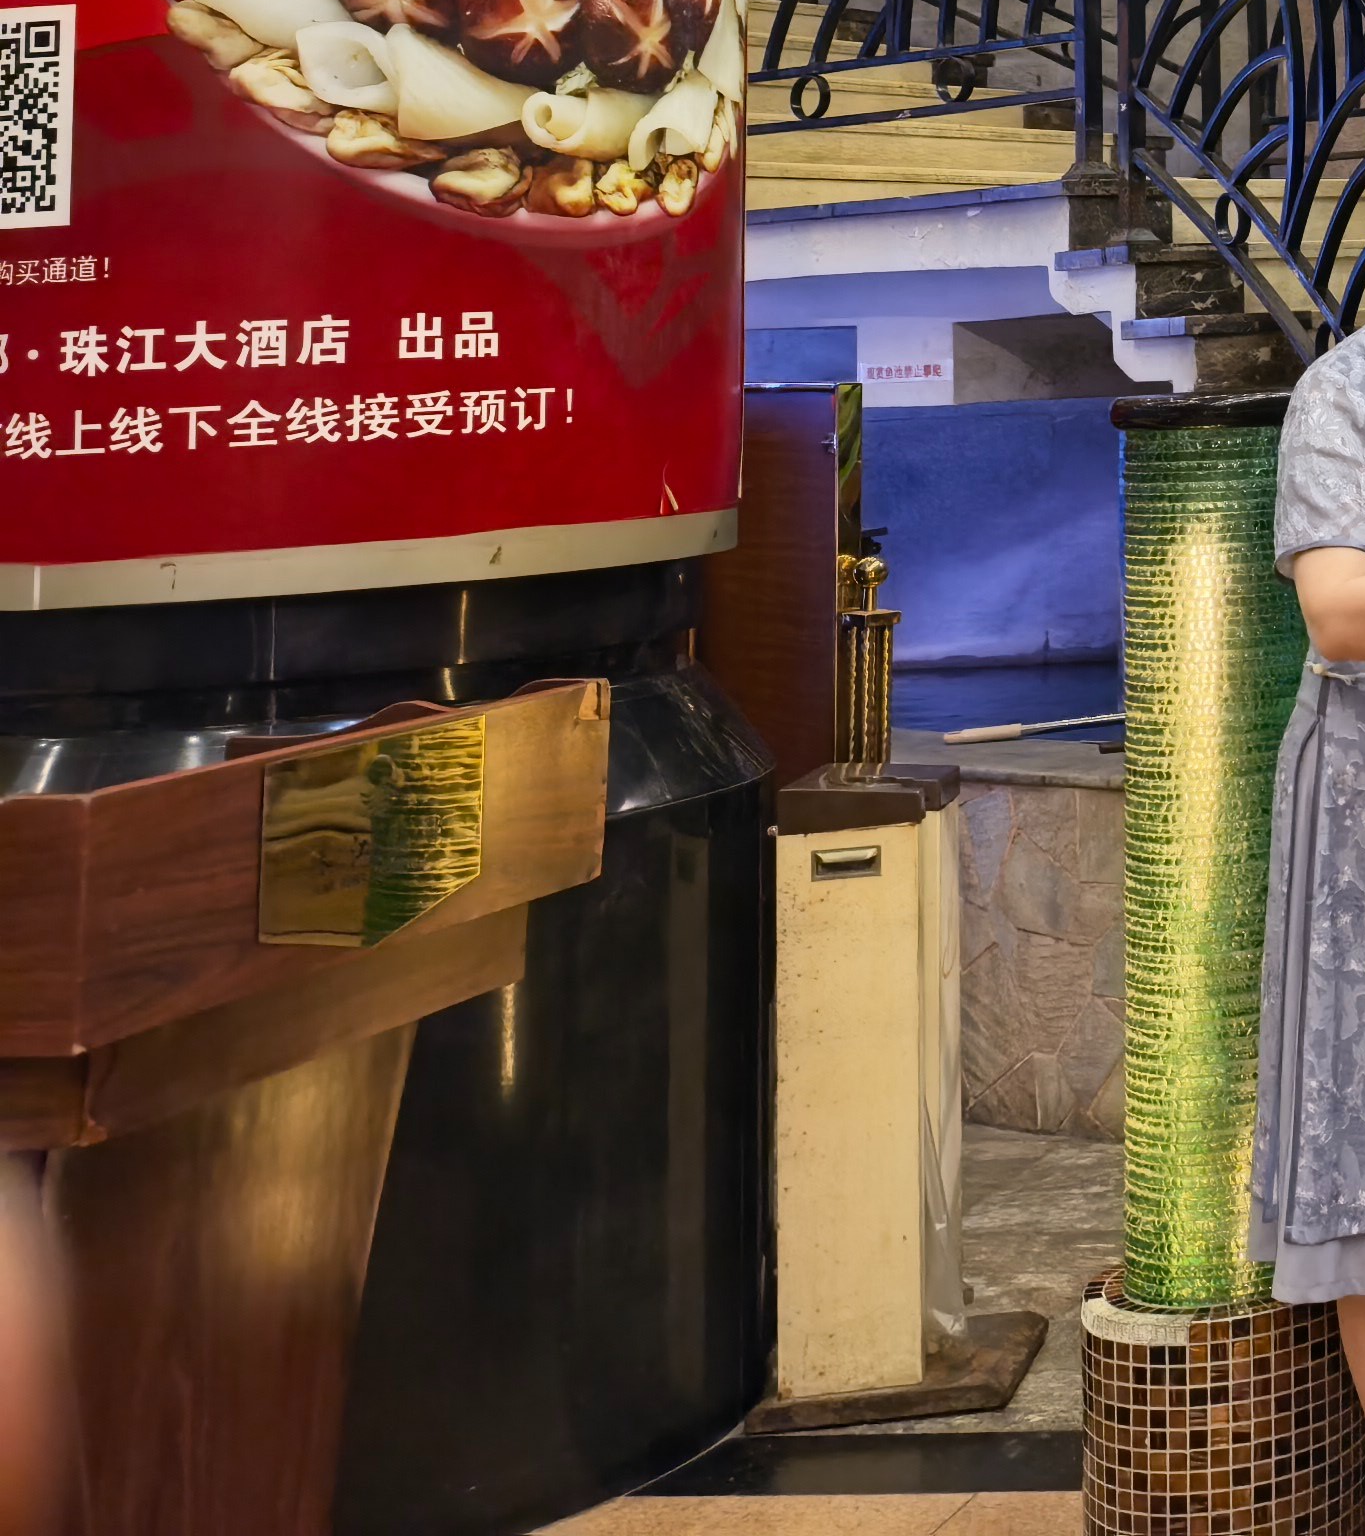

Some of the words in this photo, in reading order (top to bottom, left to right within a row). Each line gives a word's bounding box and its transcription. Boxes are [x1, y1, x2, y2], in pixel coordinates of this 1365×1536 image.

[0, 314, 350, 378] ·珠江大酒店
[398, 310, 500, 361] 出品
[0, 386, 575, 462] 线上线下全线接受预订！
